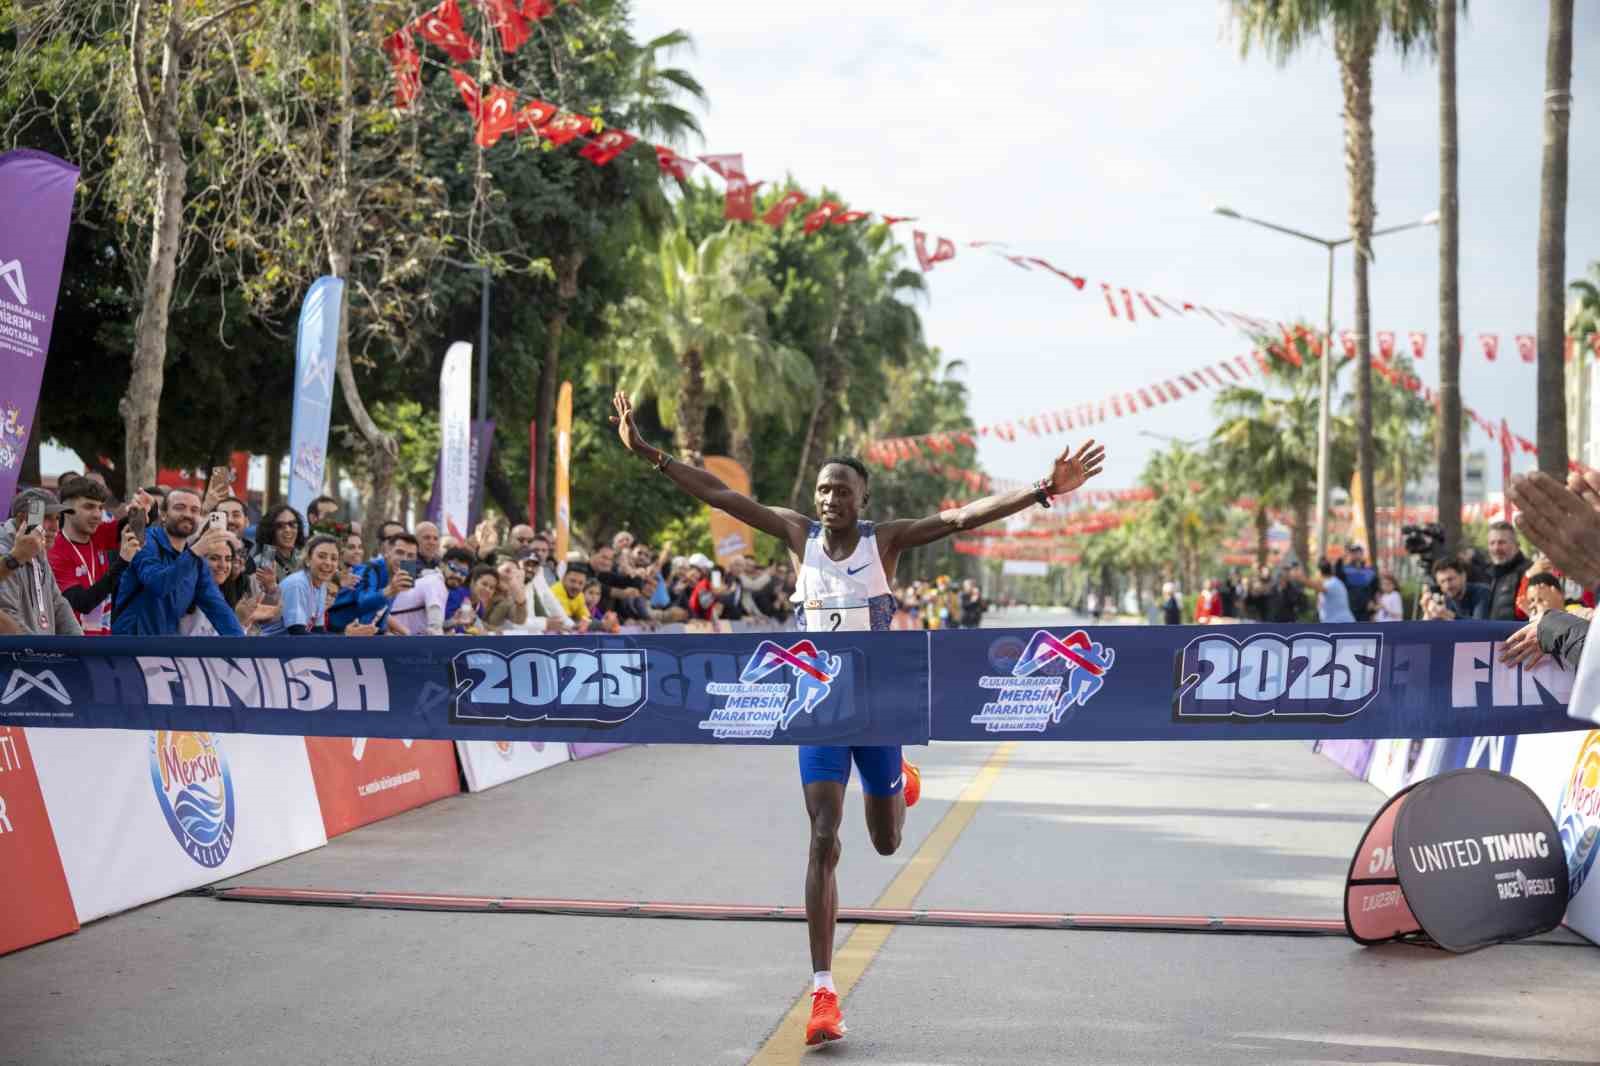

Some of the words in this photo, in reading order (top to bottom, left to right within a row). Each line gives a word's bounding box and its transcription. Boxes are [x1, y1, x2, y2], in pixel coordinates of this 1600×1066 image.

[830, 613, 842, 631] 2
[1188, 634, 1380, 705] 2025
[136, 656, 389, 711] FINISH
[462, 649, 646, 711] 2025
[727, 694, 785, 709] MERSİN
[1000, 687, 1058, 701] MERSİN
[711, 710, 780, 721] MARATONU
[983, 704, 1053, 714] MARATONU
[160, 744, 222, 792] Mersin
[1409, 838, 1481, 873] UNITED
[1482, 832, 1550, 863] TIMING
[1497, 880, 1520, 900] RACE
